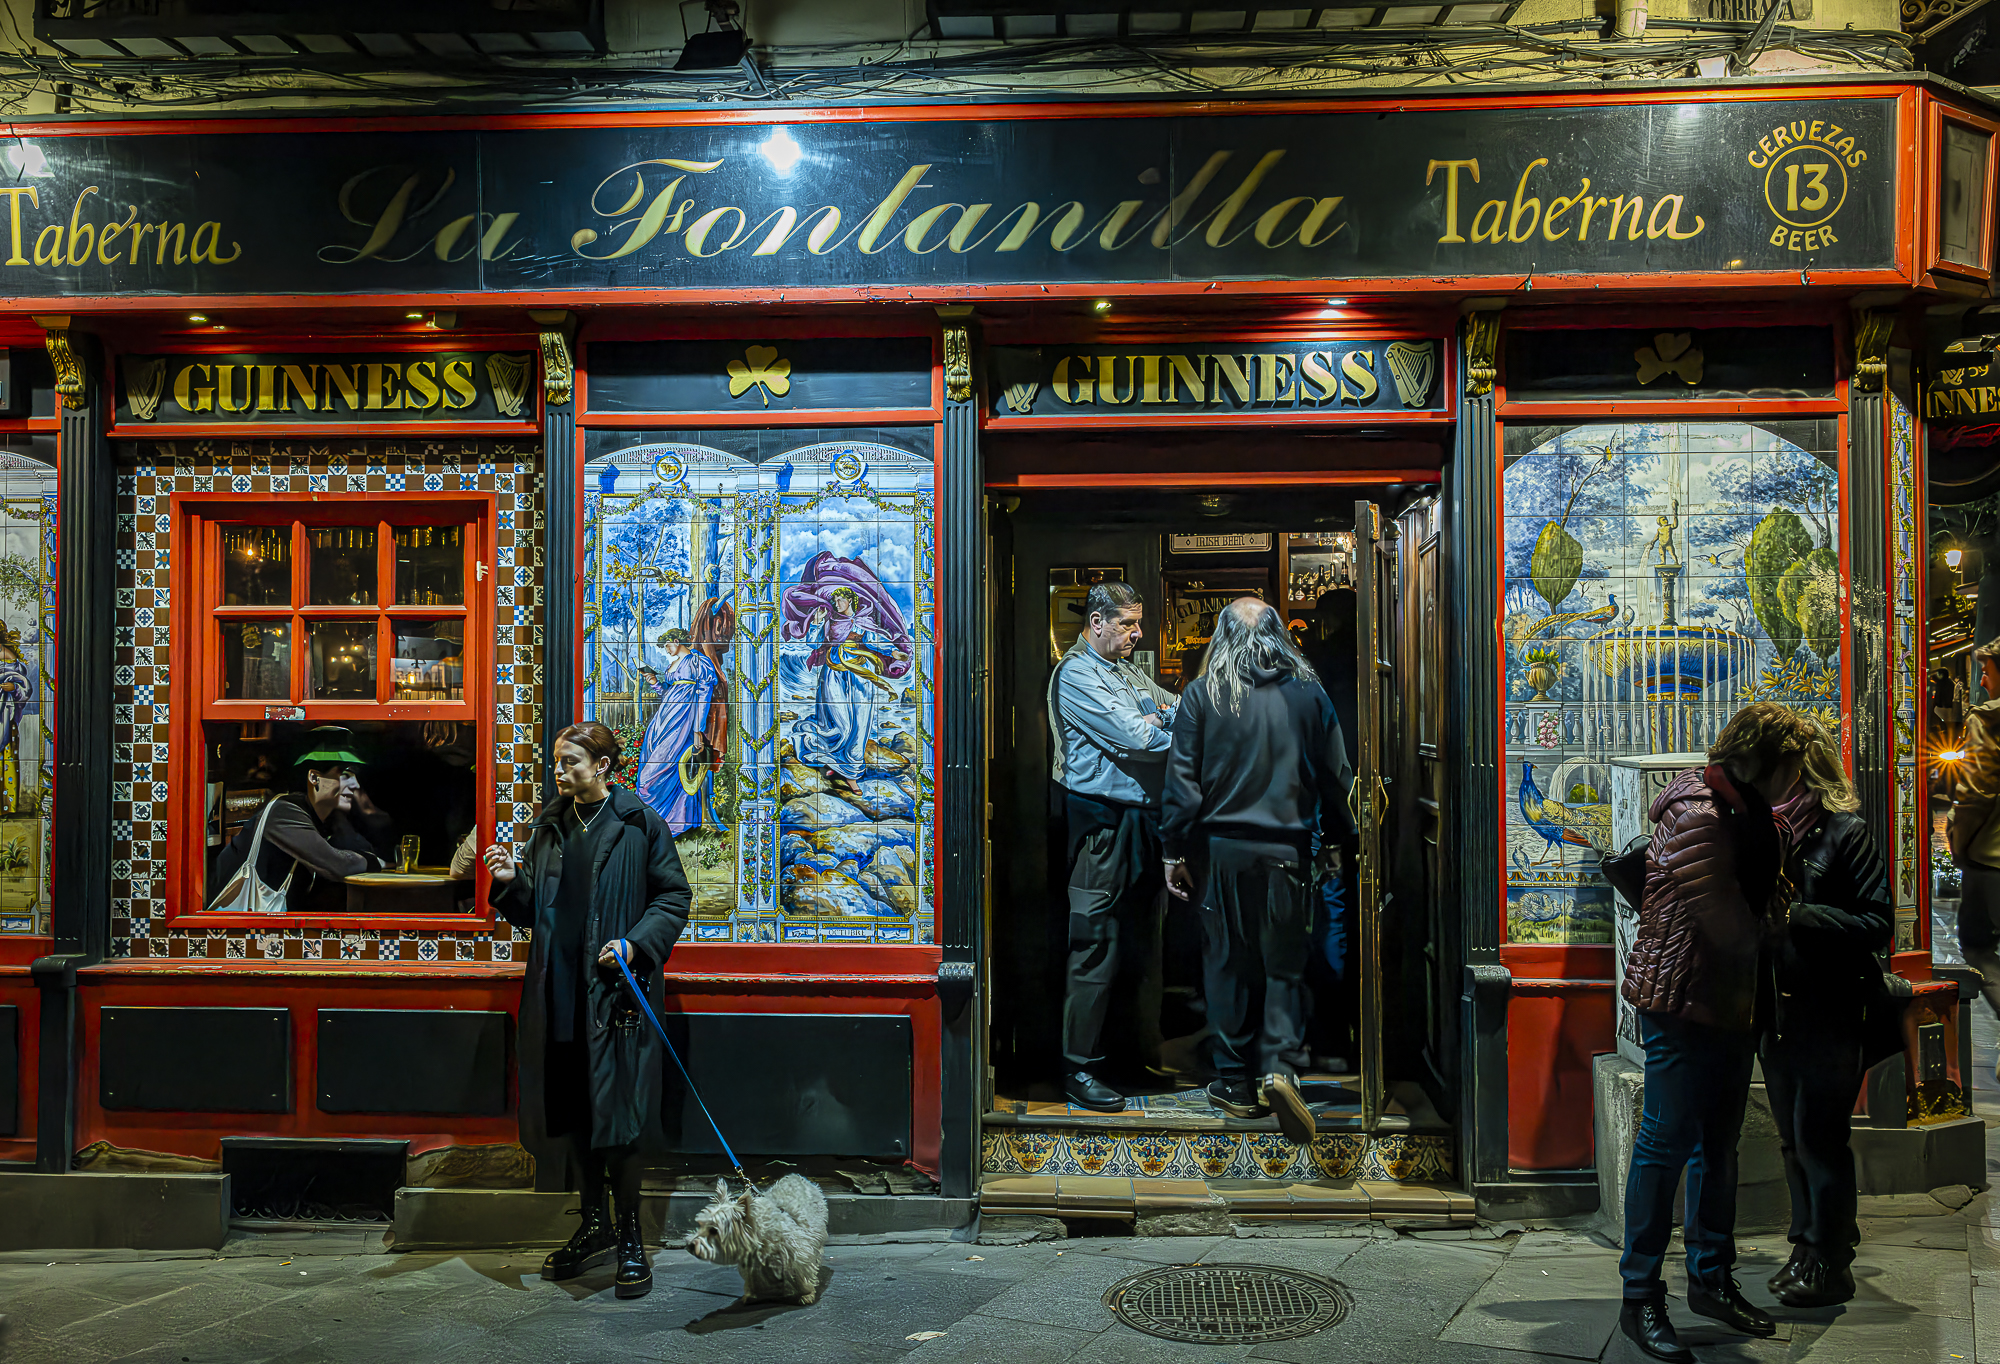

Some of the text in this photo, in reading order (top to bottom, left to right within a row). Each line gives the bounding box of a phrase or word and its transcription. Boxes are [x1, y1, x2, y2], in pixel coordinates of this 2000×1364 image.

[1707, 0, 1797, 20] CERRAA
[1747, 120, 1868, 168] CERVEZAS
[317, 148, 1349, 263] La Fontanilla
[1426, 157, 1705, 245] Taberna
[1785, 164, 1829, 211] 13
[0, 186, 242, 267] Taberna
[1769, 225, 1839, 251] BEER
[174, 360, 478, 413] GUINNESS
[1051, 350, 1380, 406] GUINNESS
